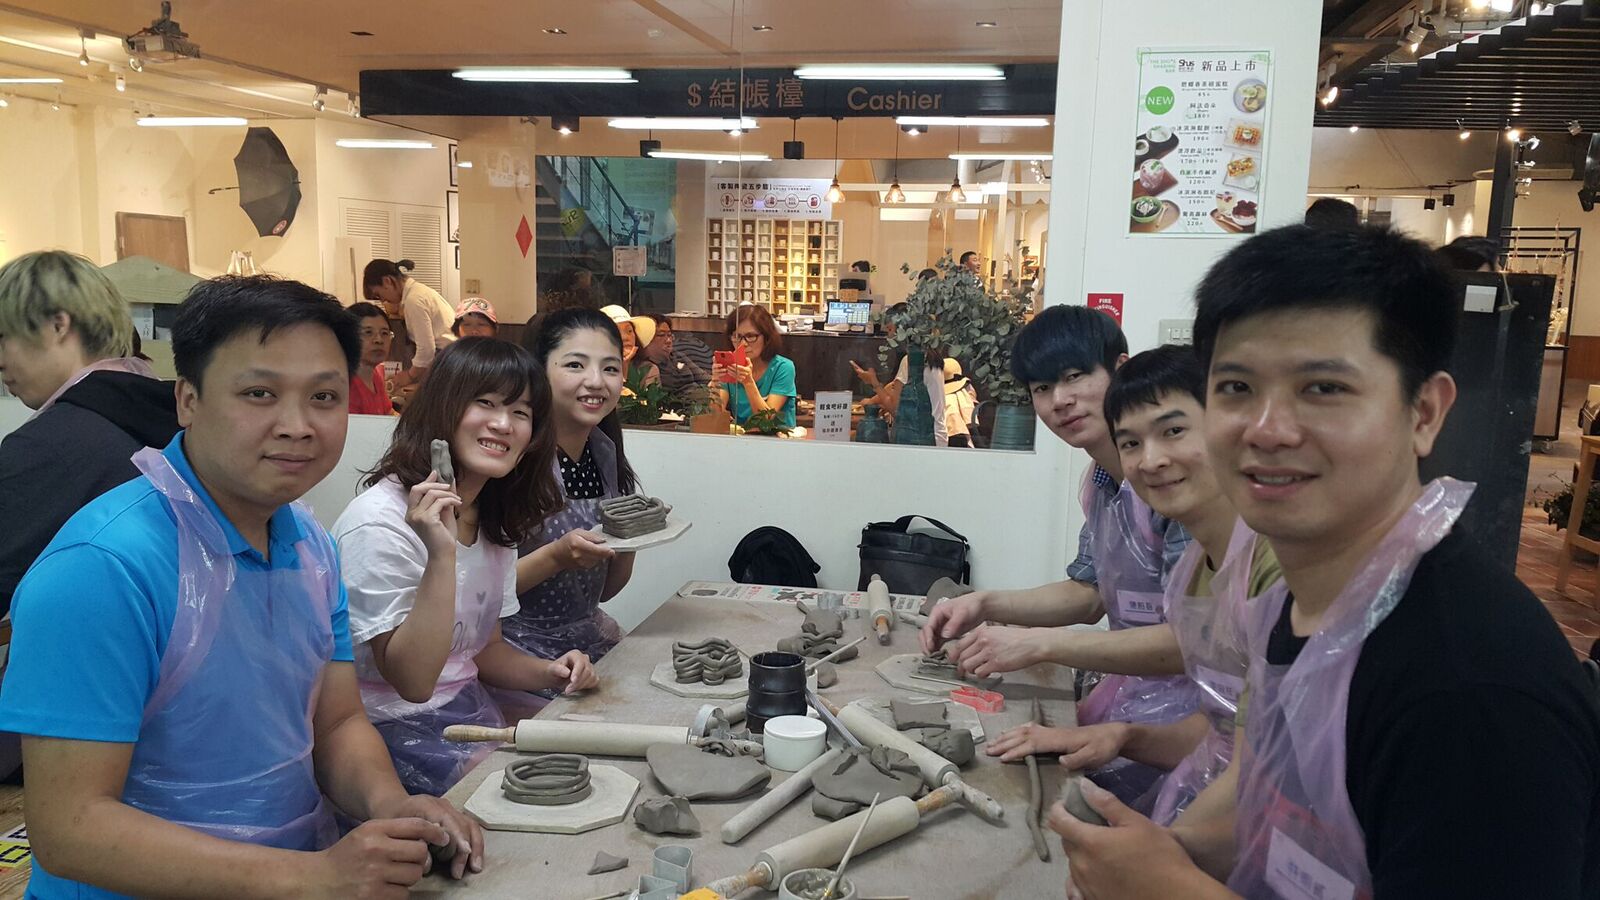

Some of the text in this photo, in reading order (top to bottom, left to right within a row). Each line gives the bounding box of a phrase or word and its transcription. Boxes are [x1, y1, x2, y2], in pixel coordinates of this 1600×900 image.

[1200, 59, 1257, 72] 新品上市
[847, 86, 942, 111] Cashier
[1147, 97, 1174, 105] NEW
